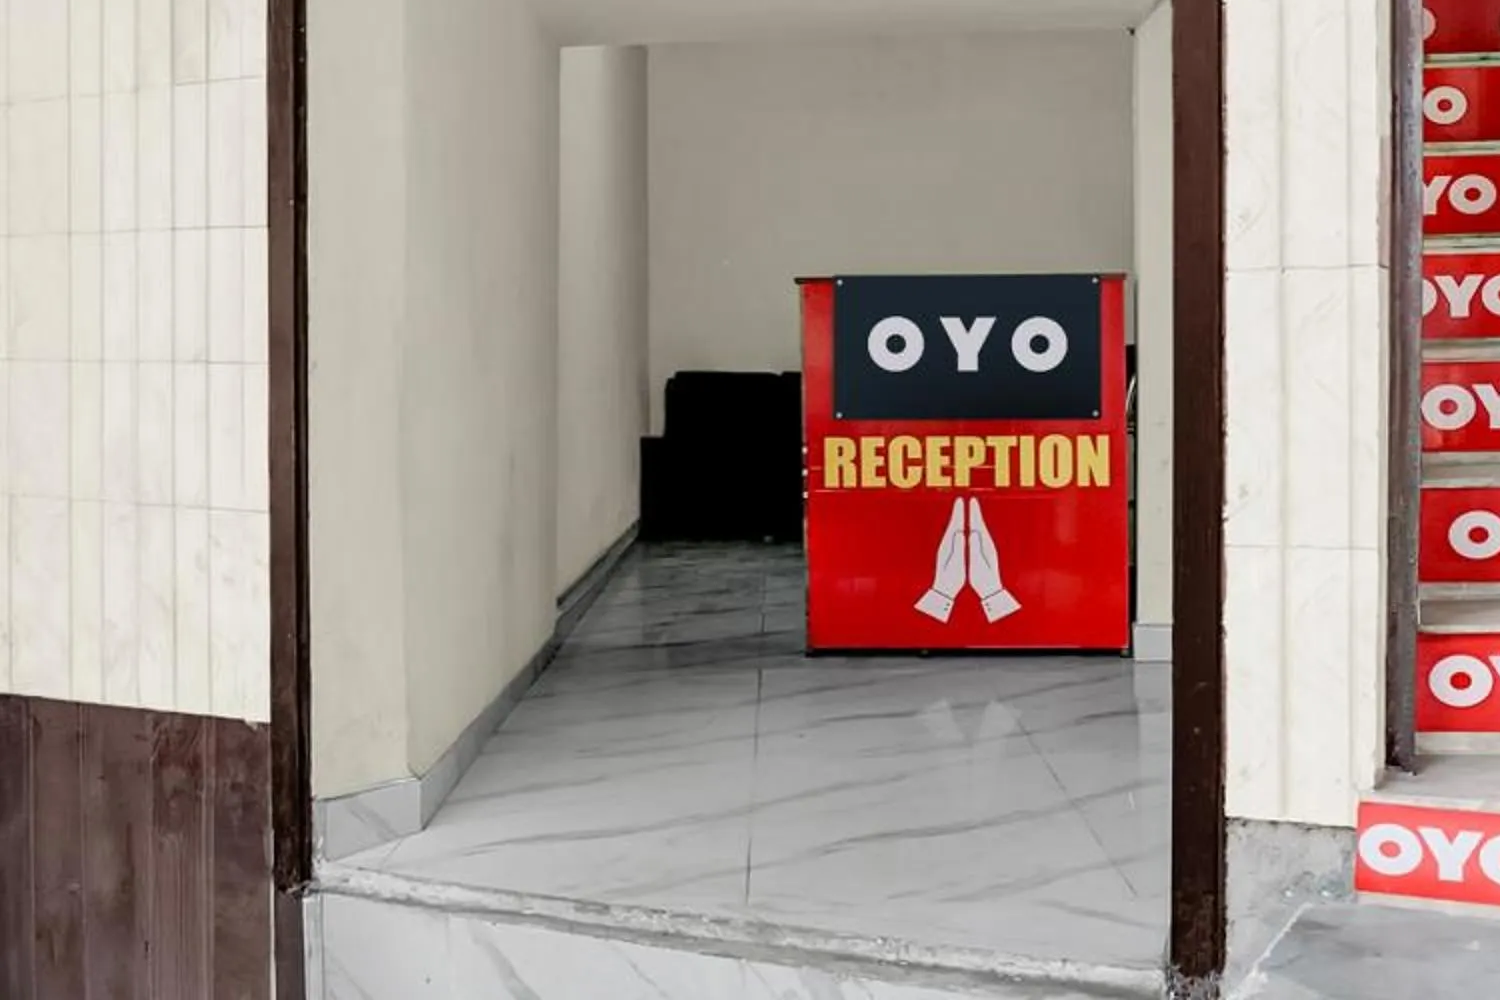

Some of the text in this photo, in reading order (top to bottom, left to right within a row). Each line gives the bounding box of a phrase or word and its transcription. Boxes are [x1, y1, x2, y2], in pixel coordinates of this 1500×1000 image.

[1423, 174, 1497, 216] YO
[867, 315, 1068, 373] OYO
[824, 434, 1110, 489] RECEPTION
